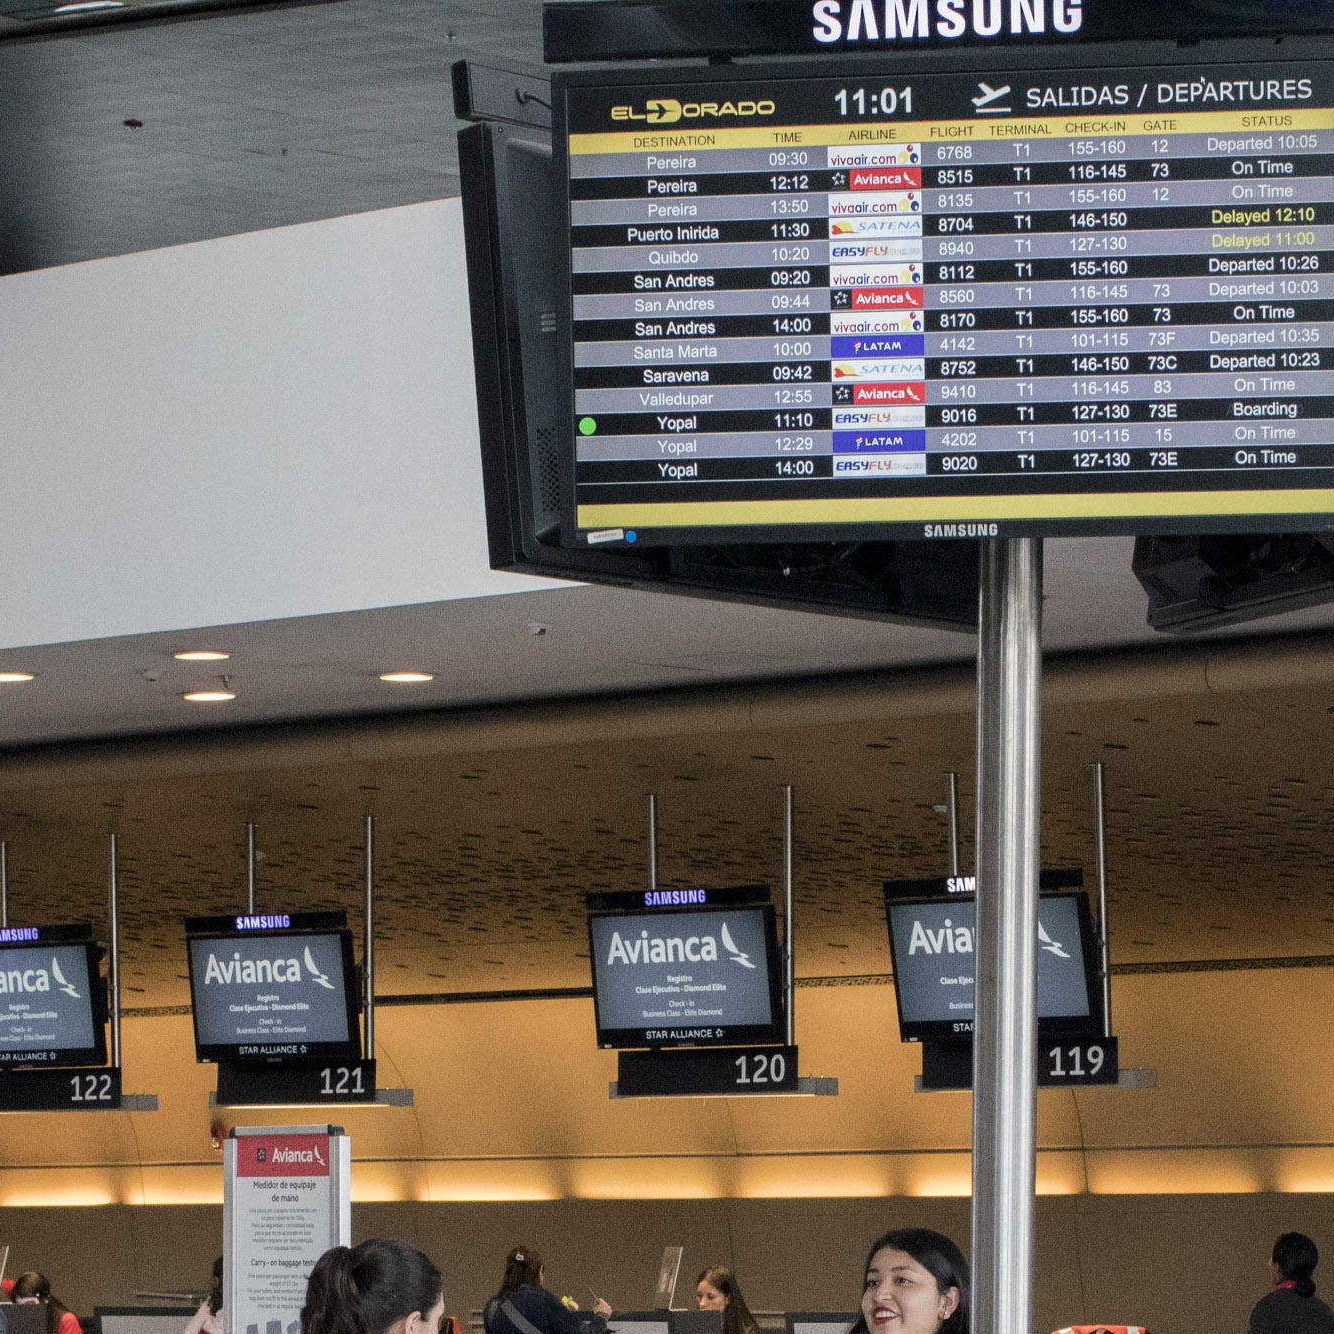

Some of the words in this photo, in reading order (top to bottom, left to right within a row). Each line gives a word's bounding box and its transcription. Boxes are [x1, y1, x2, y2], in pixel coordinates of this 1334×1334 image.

[812, 0, 1083, 43] SAMSUNG
[835, 87, 912, 115] 11:01
[1026, 84, 1129, 108] SALIDAS
[1157, 79, 1312, 104] DEPARTURES
[633, 135, 716, 148] DESTINATION
[773, 132, 803, 143] TIME
[848, 129, 897, 140] AIRLINE
[930, 125, 974, 138] FLIGHT
[988, 123, 1052, 136] TERMINAL
[1065, 121, 1126, 134] CHECK-IN
[1143, 119, 1177, 132] GATE
[1242, 115, 1292, 128] STATUS
[648, 156, 696, 169] Pereira
[769, 152, 807, 165] 09:30
[831, 154, 897, 166] vivaair.com
[938, 146, 972, 159] 6768
[1013, 143, 1029, 156] T1
[1069, 141, 1125, 155] 155-160
[1152, 140, 1168, 153] 12
[1208, 136, 1272, 152] Departed
[1279, 135, 1317, 148] 10:05
[648, 179, 697, 194] Pereira
[771, 175, 808, 190] 12:12
[854, 173, 902, 185] Avianca
[938, 170, 973, 184] 8515
[1013, 167, 1030, 180] T1
[1069, 164, 1126, 179] 116-145
[1152, 163, 1169, 177] 73
[1232, 162, 1253, 175] On
[1258, 161, 1293, 174] Time
[628, 228, 673, 241] Puerto
[678, 226, 718, 240] Inirida
[772, 223, 809, 237] 11:30
[857, 220, 920, 231] SATENA
[939, 218, 973, 232] 8704
[1014, 215, 1030, 228] T1
[1070, 212, 1127, 227] 146-150
[1212, 209, 1270, 225] Delayed
[1276, 208, 1314, 221] 12:10
[635, 299, 661, 311] San
[666, 298, 714, 311] Andres
[772, 295, 810, 308] 09:44
[856, 293, 904, 304] Avianca
[940, 289, 974, 303] 8560
[1015, 288, 1031, 300] T1
[1071, 285, 1127, 299] 116-145
[1153, 284, 1170, 297] 73
[1210, 281, 1274, 297] Departed
[1280, 280, 1318, 294] 10:03
[635, 347, 673, 359] Santa
[679, 345, 717, 358] Marta
[774, 342, 811, 355] 10:00
[864, 341, 902, 351] LATAM
[940, 337, 975, 350] 4142
[1016, 336, 1032, 348] T1
[1072, 333, 1128, 347] 101-115
[1149, 332, 1175, 346] 73F
[1210, 330, 1274, 345] Departed
[1281, 329, 1319, 342] 10:35
[644, 370, 709, 383] Saravena
[773, 366, 811, 380] 09:42
[860, 363, 922, 373] SATENA
[941, 361, 975, 375] 8752
[1016, 359, 1033, 373] T1
[1072, 356, 1128, 371] 146-150
[1149, 356, 1176, 370] 73C
[1210, 354, 1275, 369] Departed
[1281, 353, 1319, 366] 10:23
[924, 523, 998, 538] SAMSUNG
[644, 889, 706, 906] SAMSUNG
[236, 915, 290, 930] SAMSUNG
[607, 930, 718, 965] Avianca
[204, 952, 302, 985] Avianca
[667, 975, 693, 984] Registro
[636, 986, 652, 994] Clase
[652, 985, 680, 995] Ejecutiva
[684, 984, 711, 992] Diamond
[712, 983, 727, 992] Elite
[669, 1000, 684, 1008] Check
[646, 1031, 668, 1039] STAR
[670, 1029, 713, 1039] ALLIANCE
[12, 1052, 47, 1061] ALLIANCE
[239, 1046, 258, 1054] STAR
[260, 1045, 297, 1054] ALLIANCE
[1049, 1045, 1104, 1076] 119
[320, 1067, 365, 1094] 121
[735, 1054, 785, 1084] 120
[70, 1074, 112, 1101] 122
[272, 1147, 313, 1163] Avianca
[253, 1180, 279, 1190] Medidor
[280, 1180, 288, 1189] de
[289, 1180, 316, 1191] equipaje
[271, 1193, 280, 1202] de
[280, 1195, 299, 1203] mano
[250, 1258, 266, 1268] Carry
[278, 1258, 302, 1269] baggage
